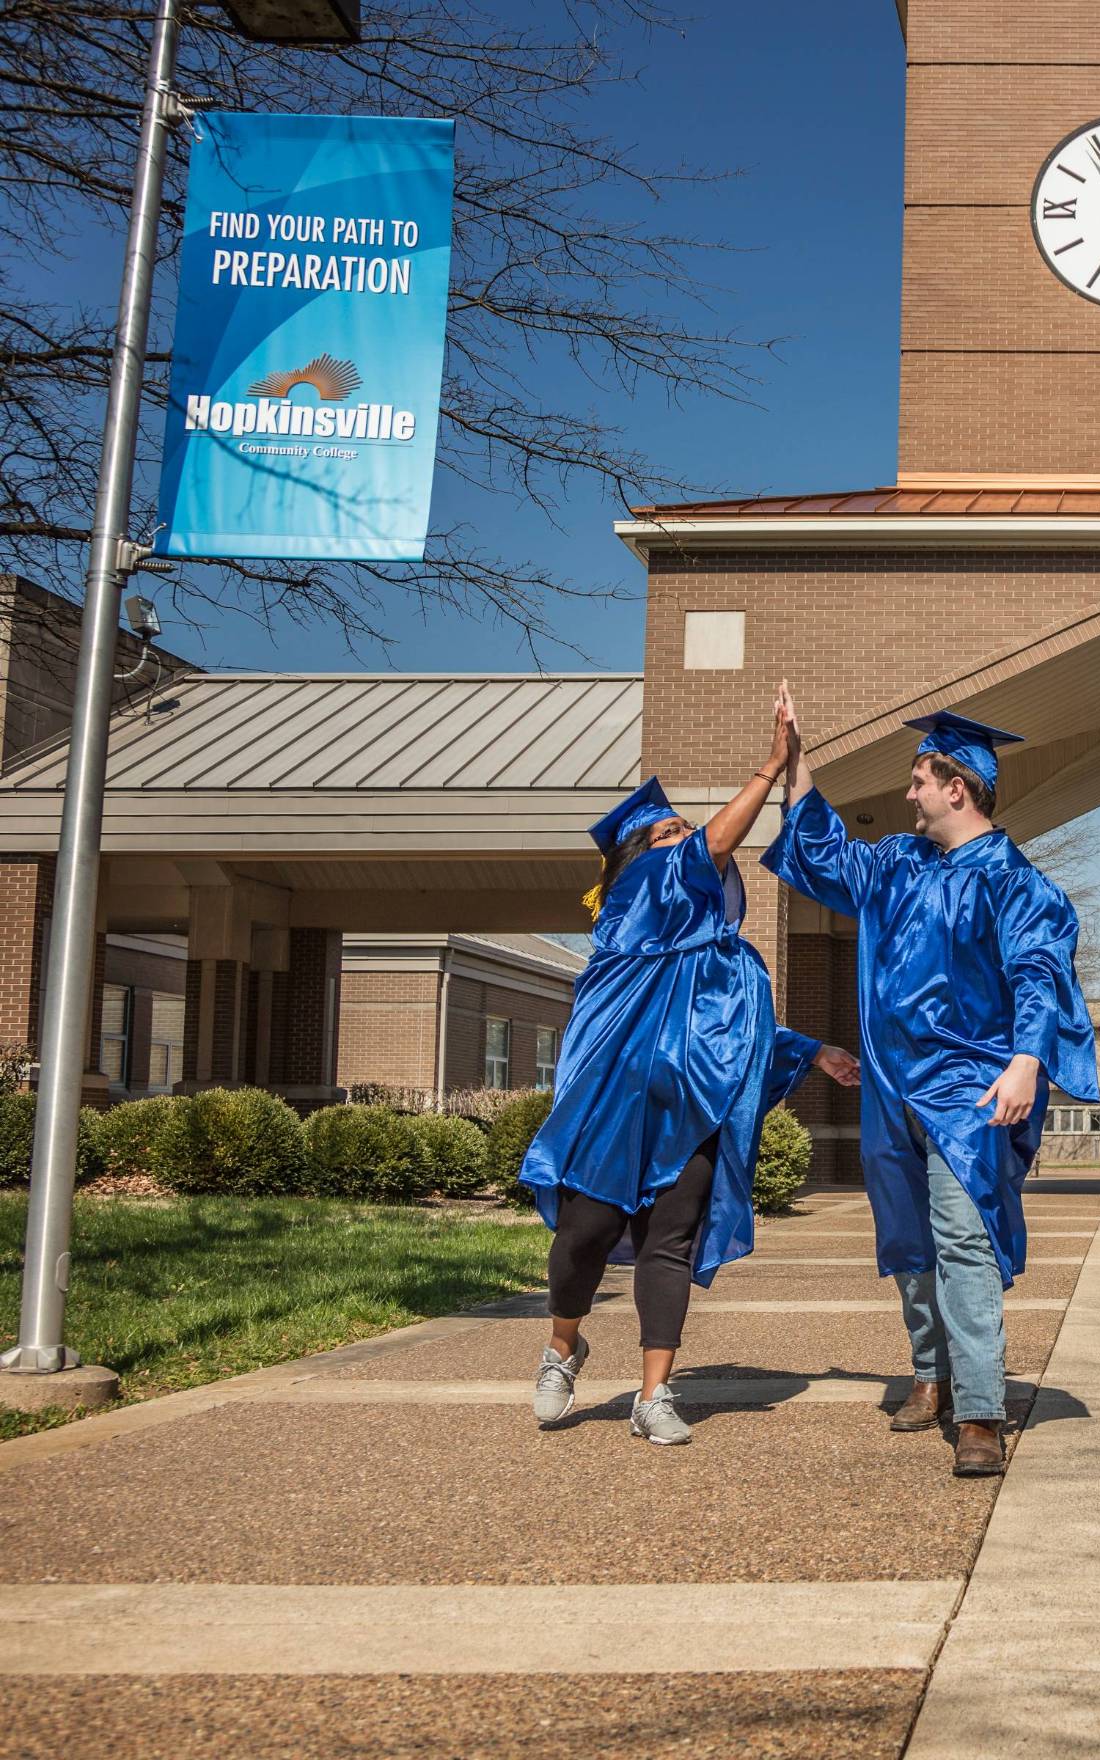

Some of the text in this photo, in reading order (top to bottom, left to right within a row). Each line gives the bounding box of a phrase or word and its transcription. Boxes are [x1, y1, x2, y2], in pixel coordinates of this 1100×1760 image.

[210, 211, 419, 248] FIND YOUR PATH TO
[212, 250, 411, 295] PREPARATION
[184, 394, 416, 441] Hopkinsville
[239, 441, 358, 460] Community College
